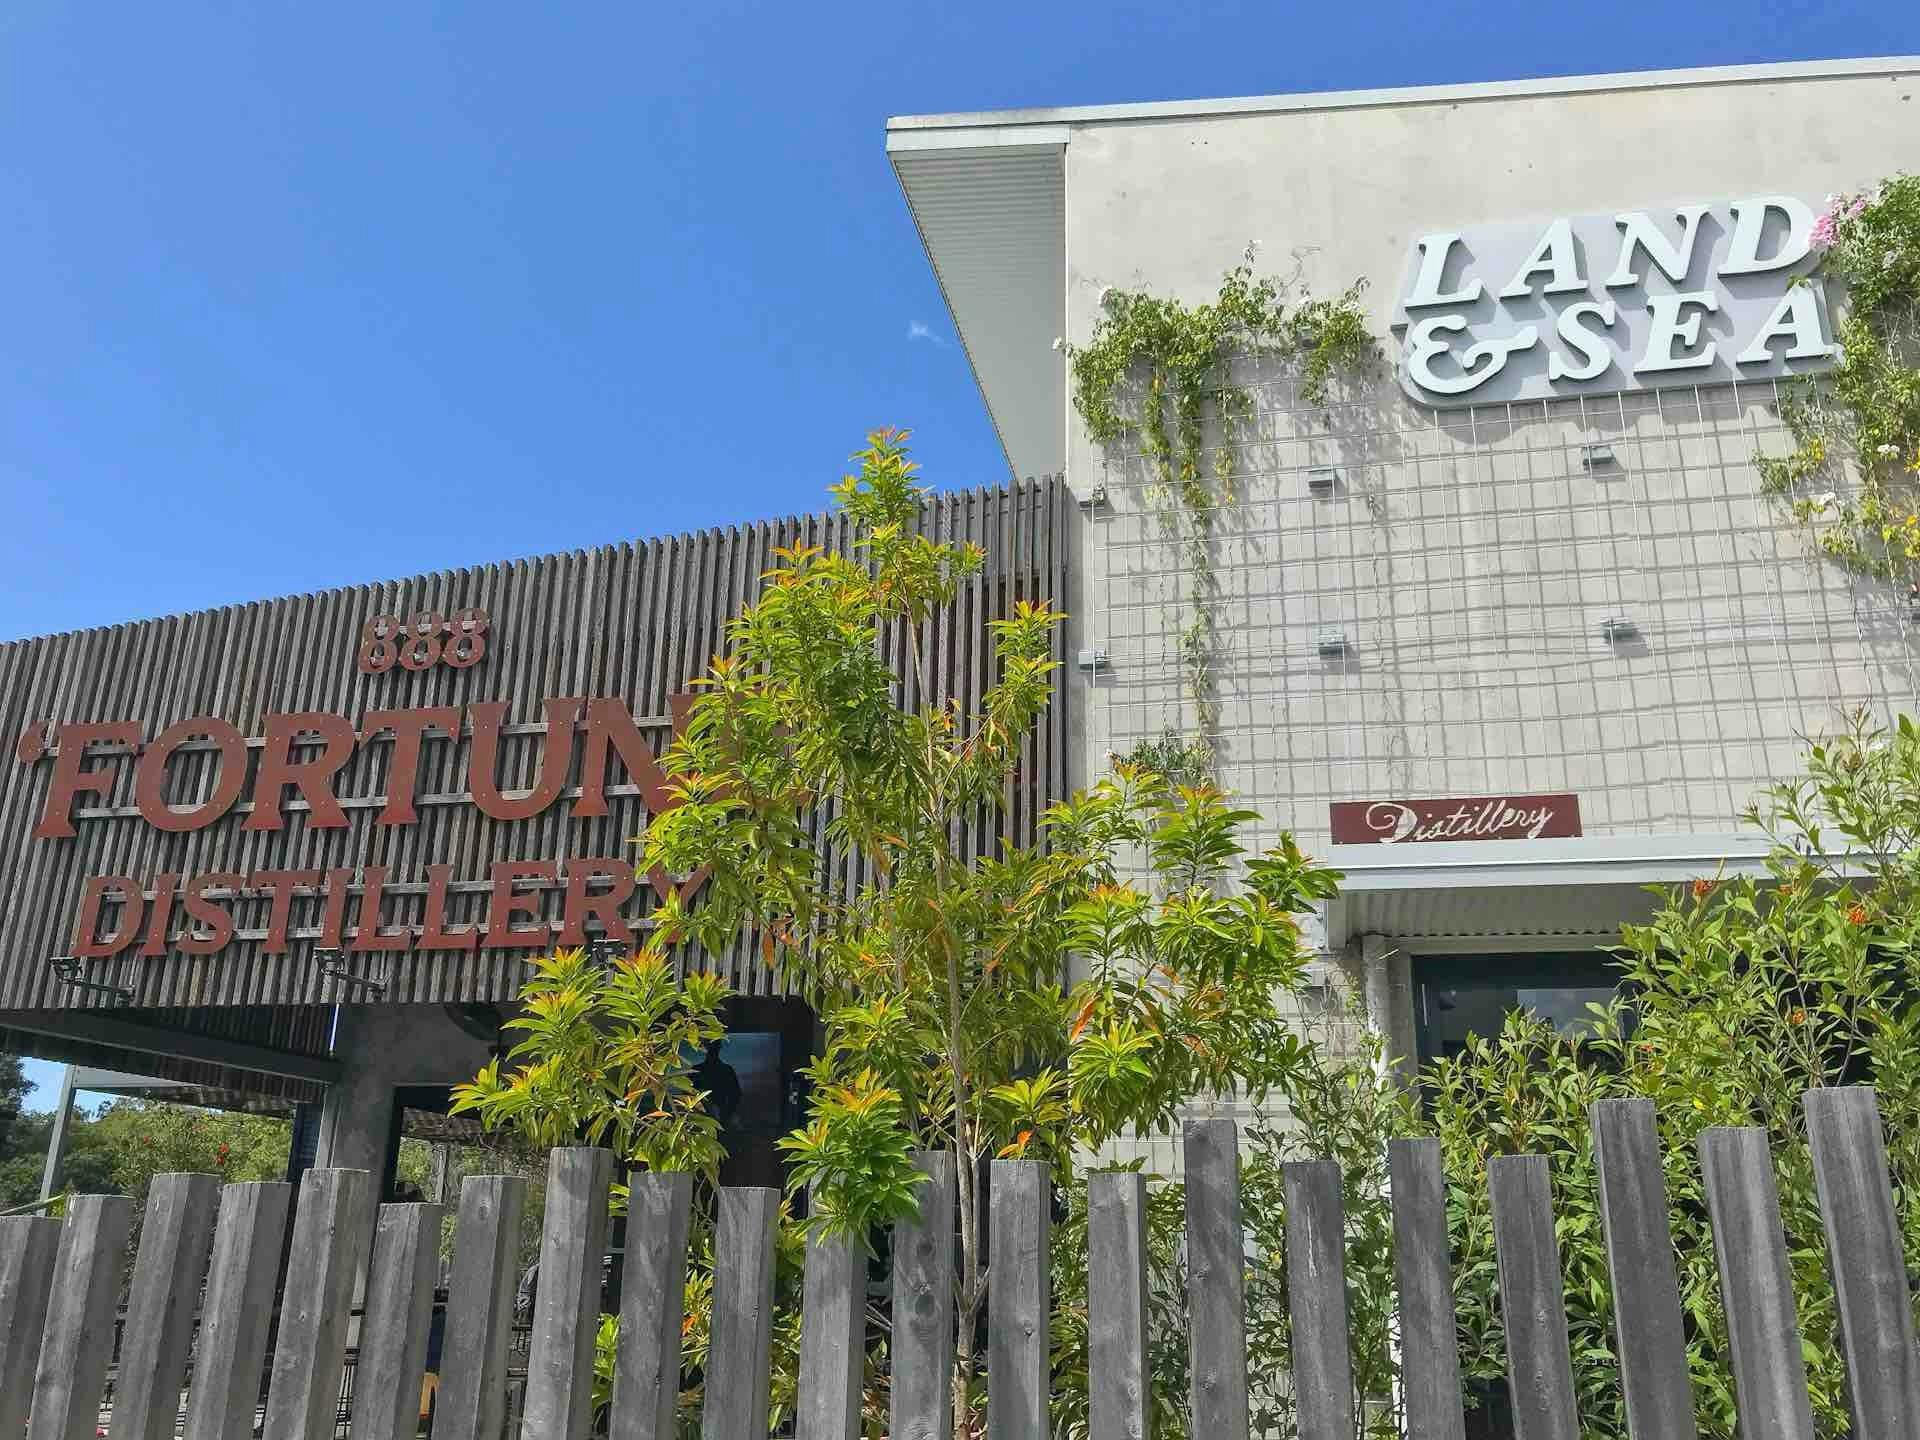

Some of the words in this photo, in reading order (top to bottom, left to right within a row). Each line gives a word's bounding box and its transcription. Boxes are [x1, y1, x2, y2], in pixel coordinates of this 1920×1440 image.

[1404, 198, 1818, 308] LAND
[1408, 315, 1538, 394] &
[1549, 280, 1842, 382] SEA
[359, 608, 487, 673] 888
[1366, 800, 1553, 843] Distillery
